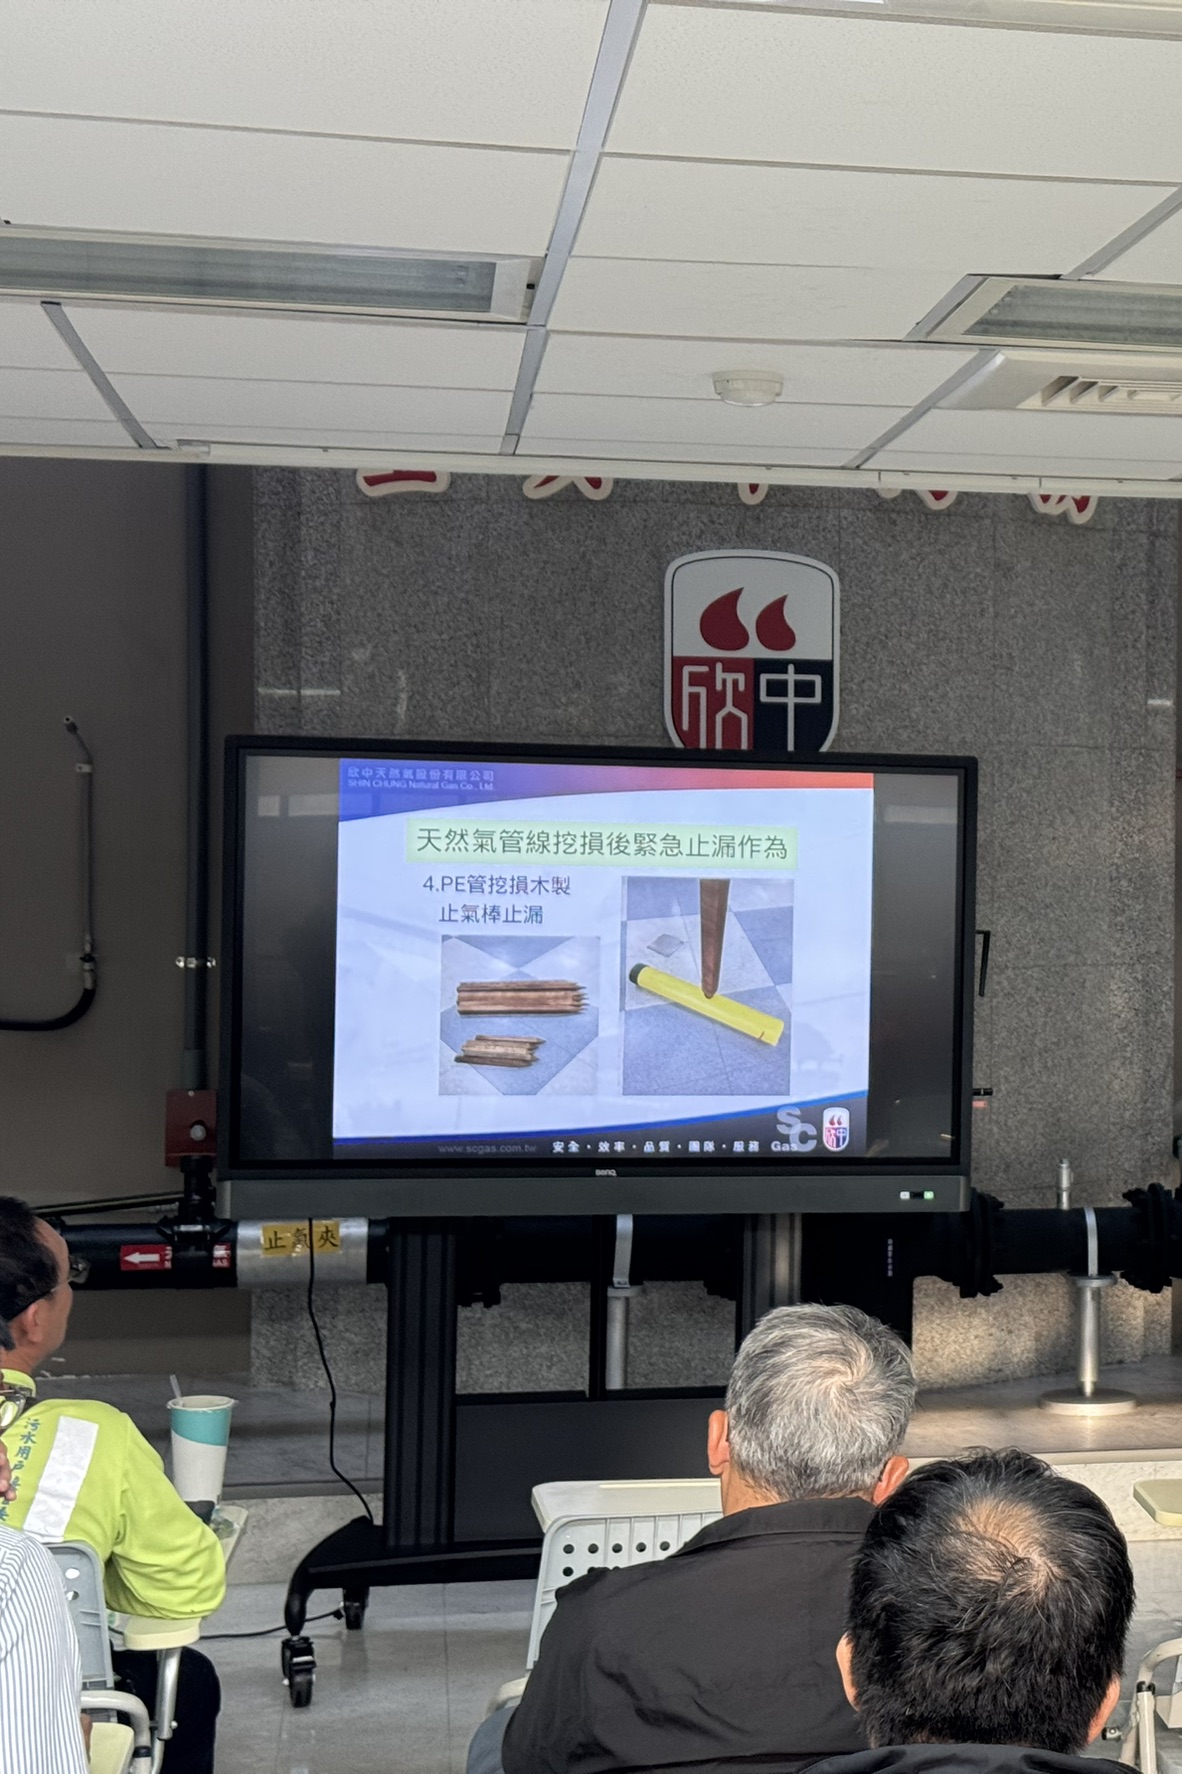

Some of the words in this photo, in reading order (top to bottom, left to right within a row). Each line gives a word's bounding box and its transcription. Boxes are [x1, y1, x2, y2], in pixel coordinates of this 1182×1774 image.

[348, 767, 494, 781] 欣中天然氣股份有限公司
[348, 779, 371, 787] SHIN
[372, 780, 407, 788] CHUNG
[409, 781, 440, 789] Natural
[441, 781, 459, 790] Gas
[416, 827, 788, 860] 天然氣管線挖損後緊急止漏作為
[422, 875, 571, 896] 4.PE管挖損木製
[438, 903, 543, 924] 止氣棒止漏
[438, 1143, 537, 1154] www.scgas.com.tw
[771, 1141, 797, 1151] Gas
[265, 1225, 339, 1250] 止氣夾
